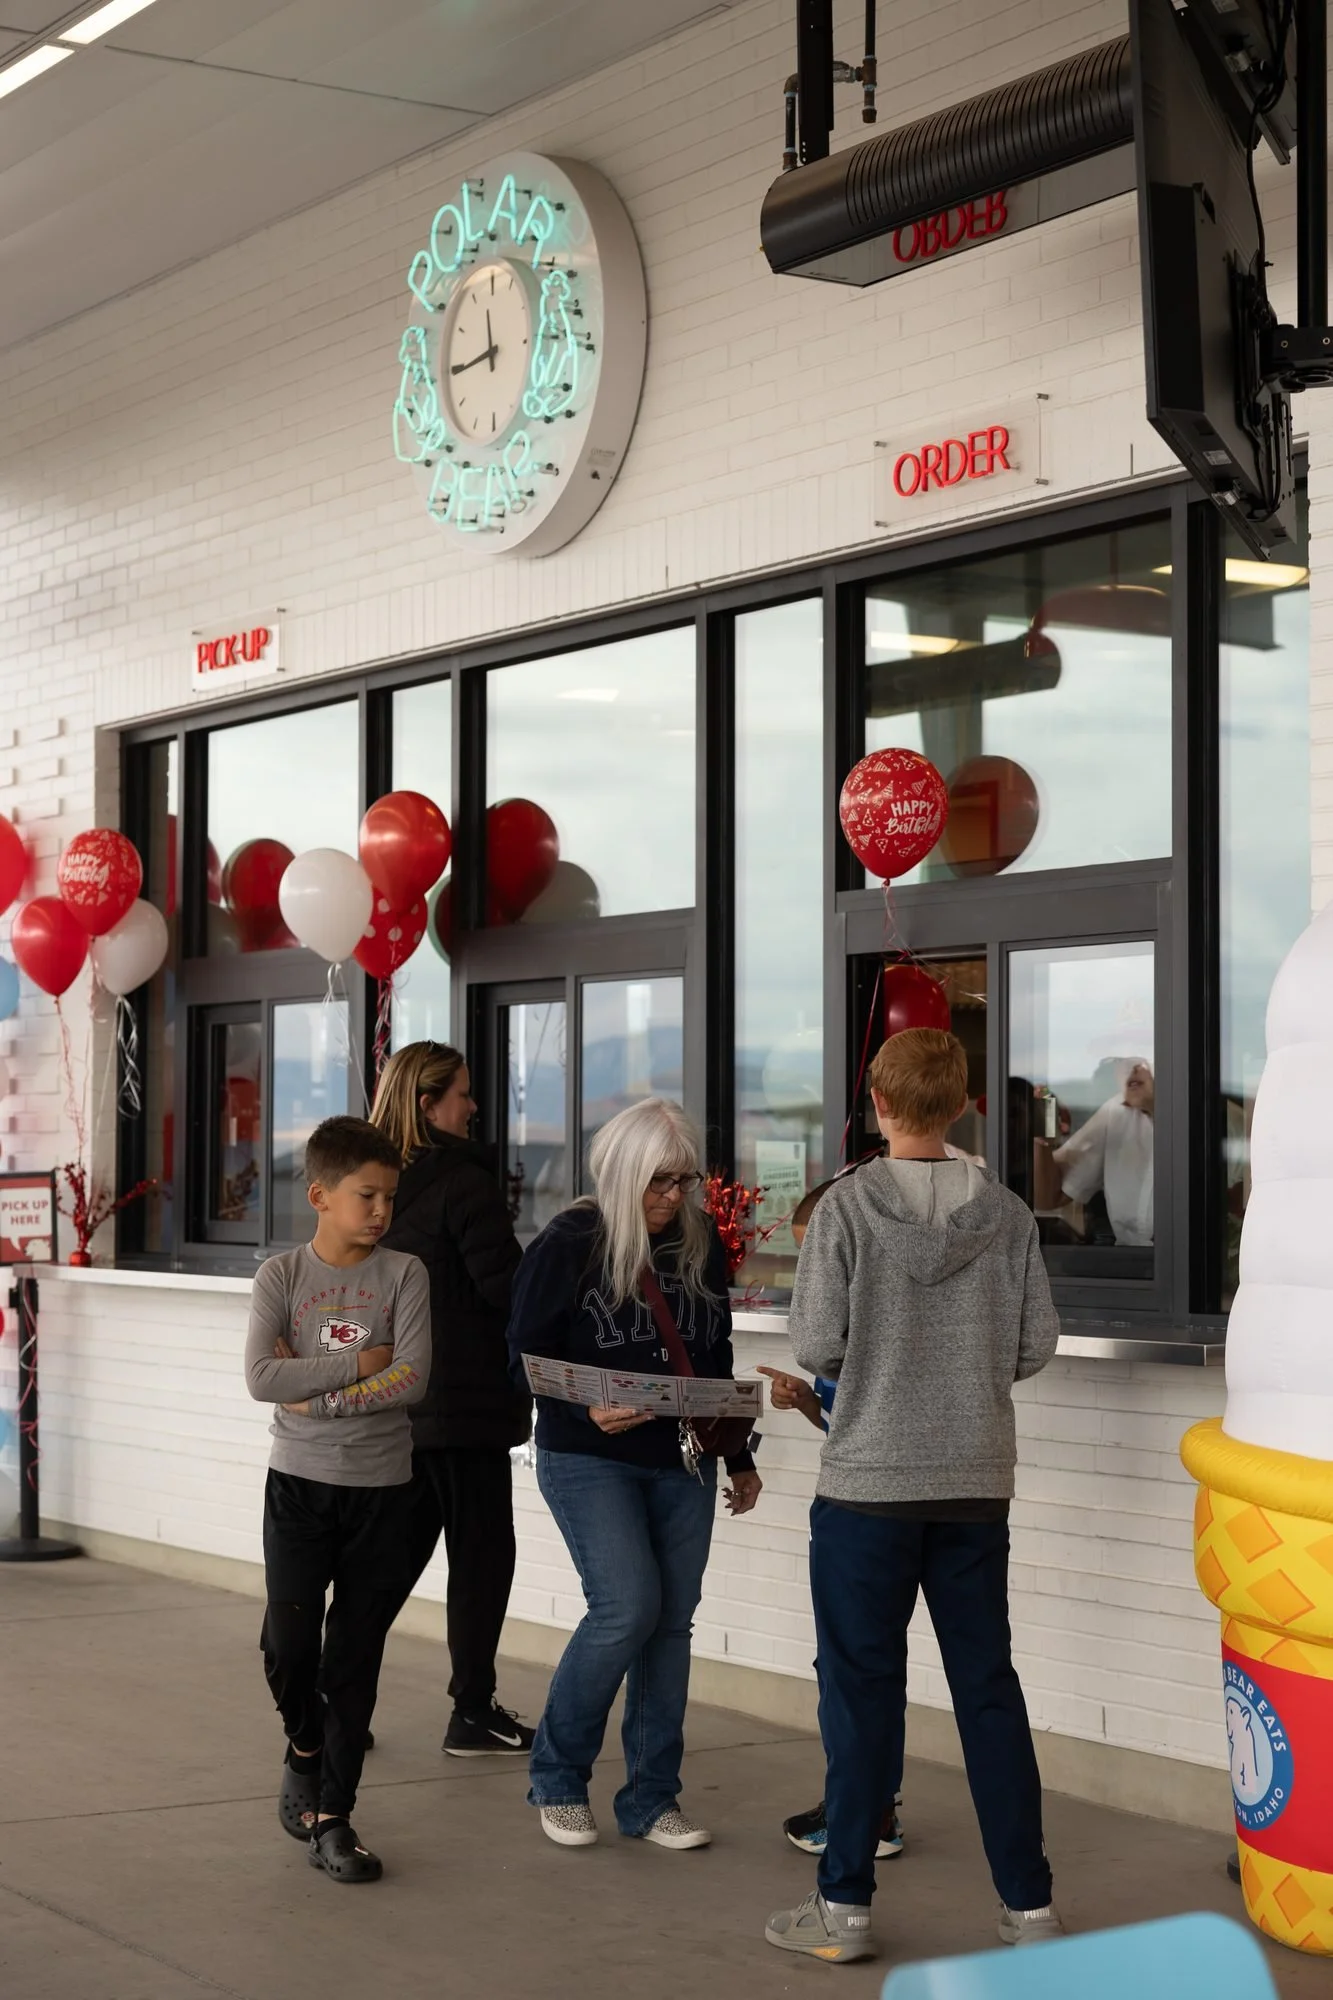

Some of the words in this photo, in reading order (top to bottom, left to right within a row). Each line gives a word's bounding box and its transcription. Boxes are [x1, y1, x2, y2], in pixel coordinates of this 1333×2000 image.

[408, 174, 555, 313] POLAR
[893, 425, 1010, 497] ORDER
[427, 430, 536, 532] BEAR
[197, 626, 269, 673] PICK-UP
[884, 814, 941, 838] Birthday
[890, 800, 935, 818] HAPPY
[67, 852, 101, 867] HAPPY
[1, 1201, 29, 1211] PICK
[32, 1200, 49, 1209] UP
[10, 1215, 41, 1226] HERE
[292, 1286, 348, 1337] PROPERTY
[359, 1289, 375, 1301] OF
[330, 1324, 358, 1344] KC
[1227, 1666, 1254, 1700] BEAR
[1256, 1699, 1287, 1752] EATS
[1253, 1787, 1284, 1823] IDAHO
